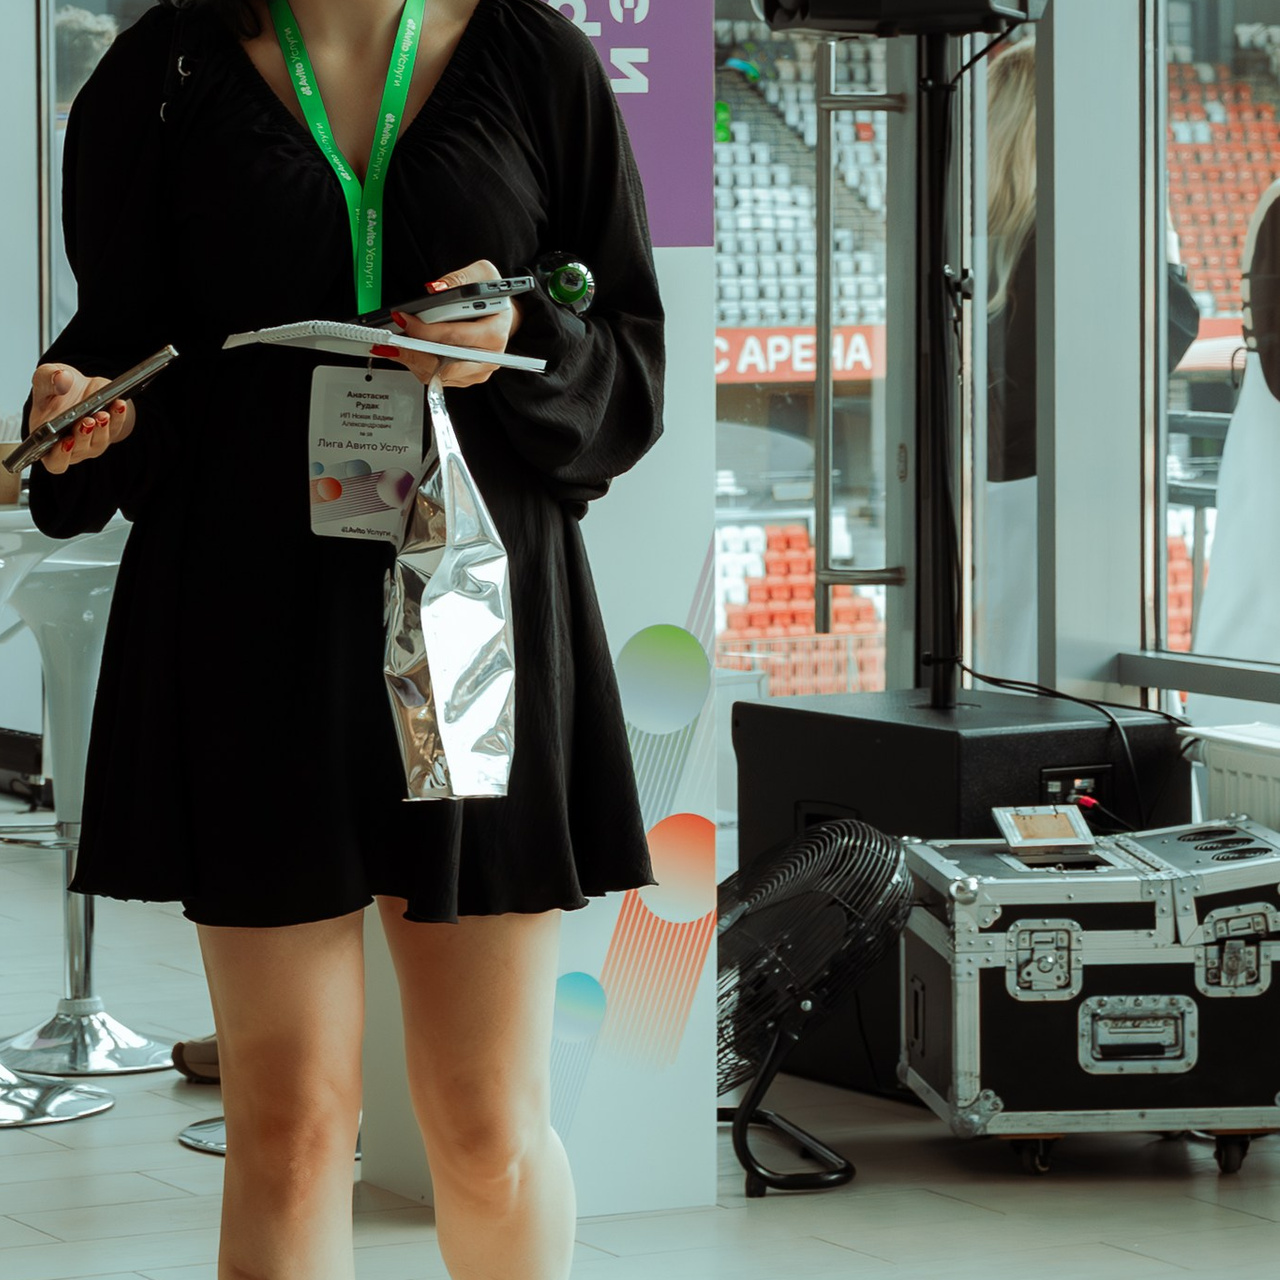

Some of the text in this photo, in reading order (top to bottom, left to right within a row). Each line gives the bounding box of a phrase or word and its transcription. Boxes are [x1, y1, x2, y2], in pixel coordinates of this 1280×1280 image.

[284, 27, 309, 88] Avito Услуги
[394, 28, 415, 87] Avito Услуги
[610, 47, 650, 94] и
[373, 123, 393, 180] Avito Услуги
[364, 220, 377, 288] Avito Услуги
[347, 391, 389, 400] Анастасия
[355, 401, 379, 410] Рудак
[318, 438, 409, 454] Лига Авито Услуг
